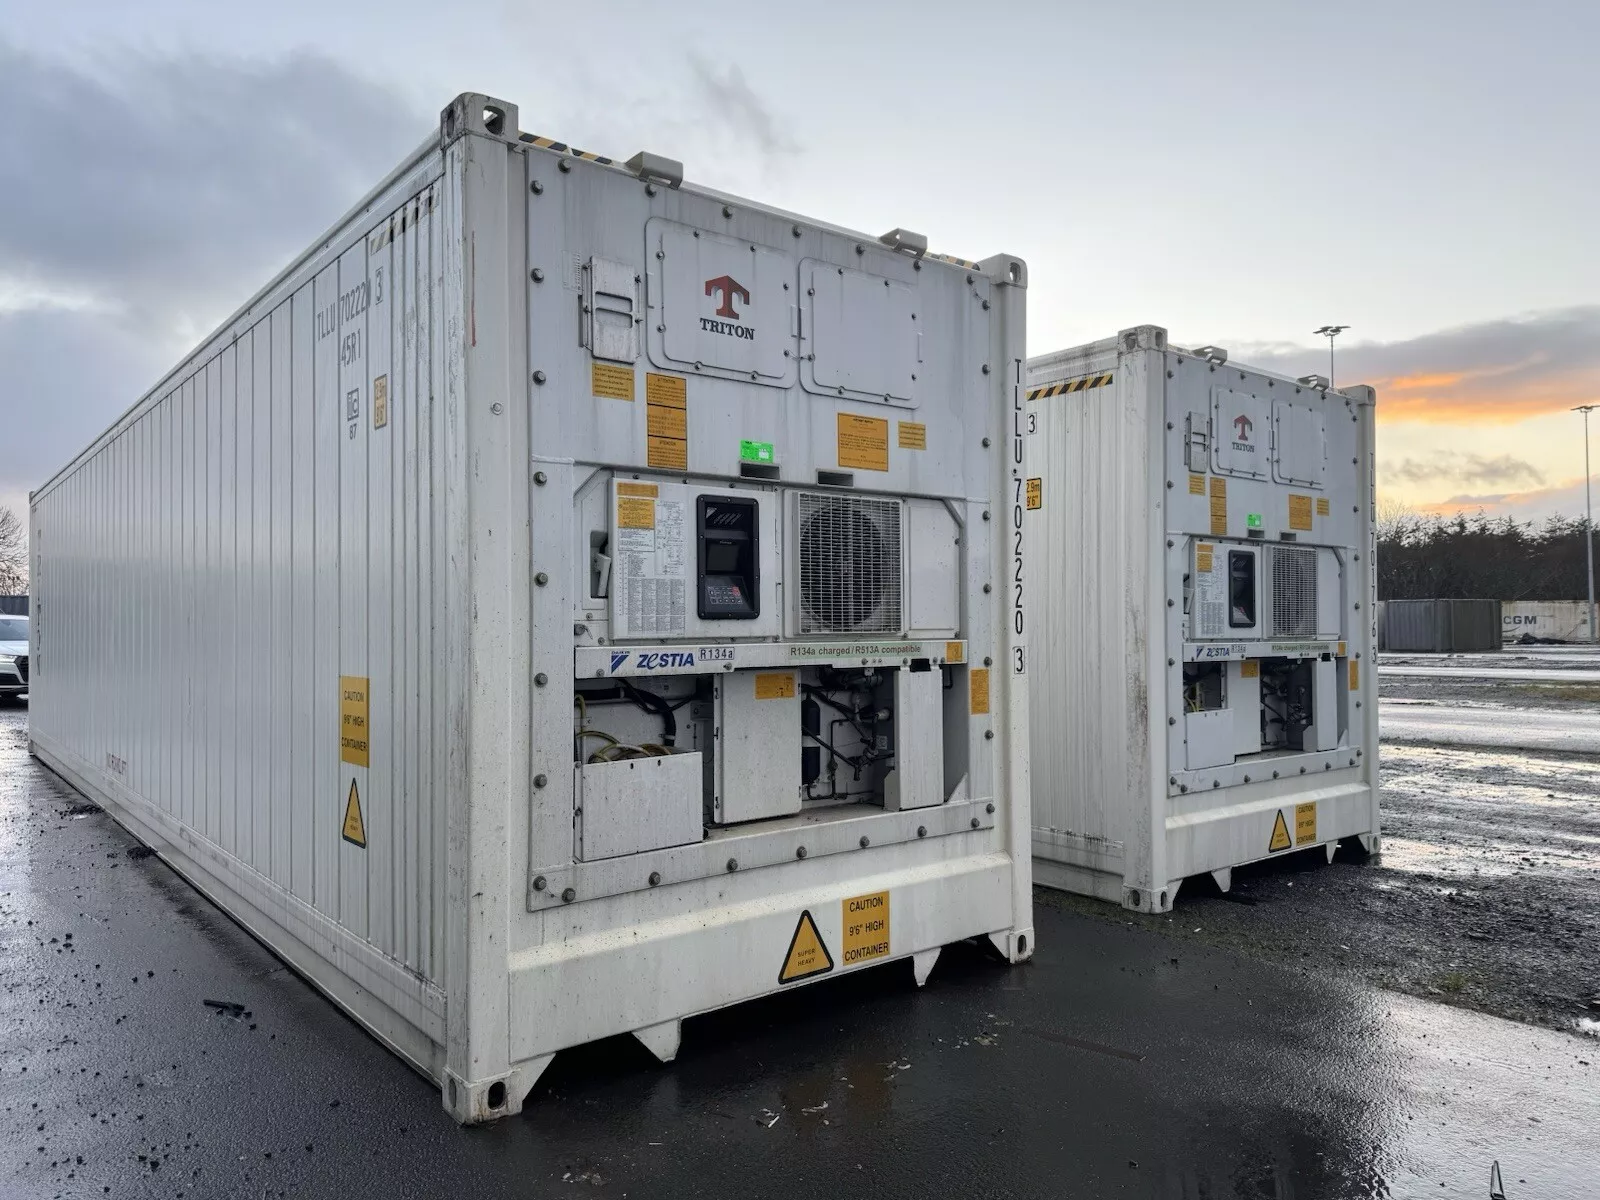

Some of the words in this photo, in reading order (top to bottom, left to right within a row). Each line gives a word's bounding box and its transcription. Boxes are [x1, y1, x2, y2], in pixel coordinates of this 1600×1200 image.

[317, 302, 336, 342] TLLU
[700, 317, 755, 340] TRITON
[341, 328, 361, 367] 45R1
[1014, 358, 1022, 464] TLLU
[349, 423, 357, 440] 87
[1028, 414, 1036, 433] 3
[1231, 442, 1255, 453] TRITON
[1014, 478, 1023, 635] 702220
[1503, 615, 1537, 625] CGM
[700, 647, 733, 660] R134a
[791, 647, 816, 656] R134a
[818, 645, 850, 657] charged
[855, 645, 880, 655] R513A
[881, 645, 921, 655] compatible
[1016, 648, 1024, 672] 3
[344, 690, 365, 702] CAUTION
[849, 896, 883, 912] CAUTION
[849, 924, 863, 936] 9'6"
[865, 919, 884, 932] HIGH
[797, 948, 816, 957] SUPER
[844, 941, 889, 961] CONTAINER
[797, 957, 815, 967] HEAVY
